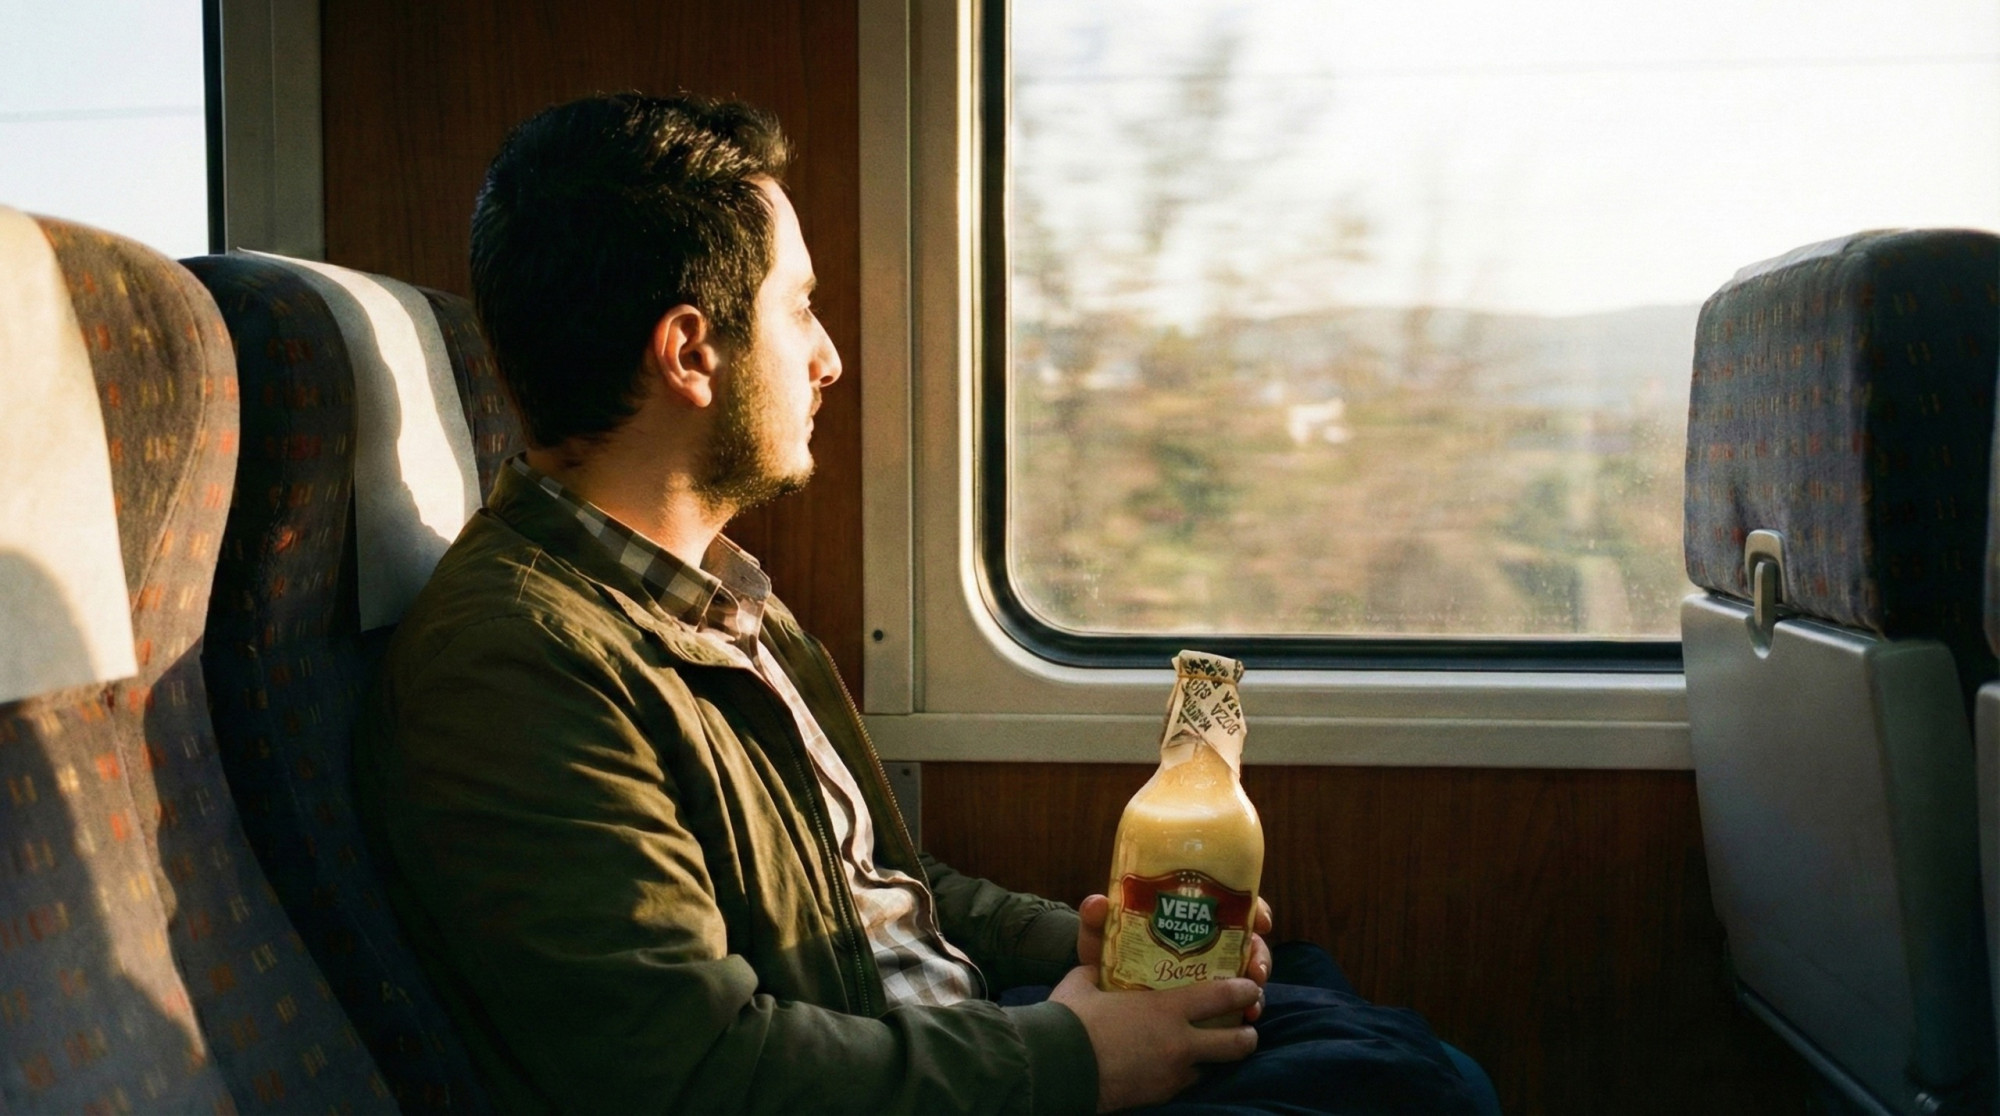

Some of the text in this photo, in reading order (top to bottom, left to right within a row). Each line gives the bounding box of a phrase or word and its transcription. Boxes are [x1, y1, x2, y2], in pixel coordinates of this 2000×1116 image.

[1161, 897, 1212, 921] VEFA
[1157, 918, 1210, 935] BOZACISI
[1154, 959, 1208, 982] Boza
